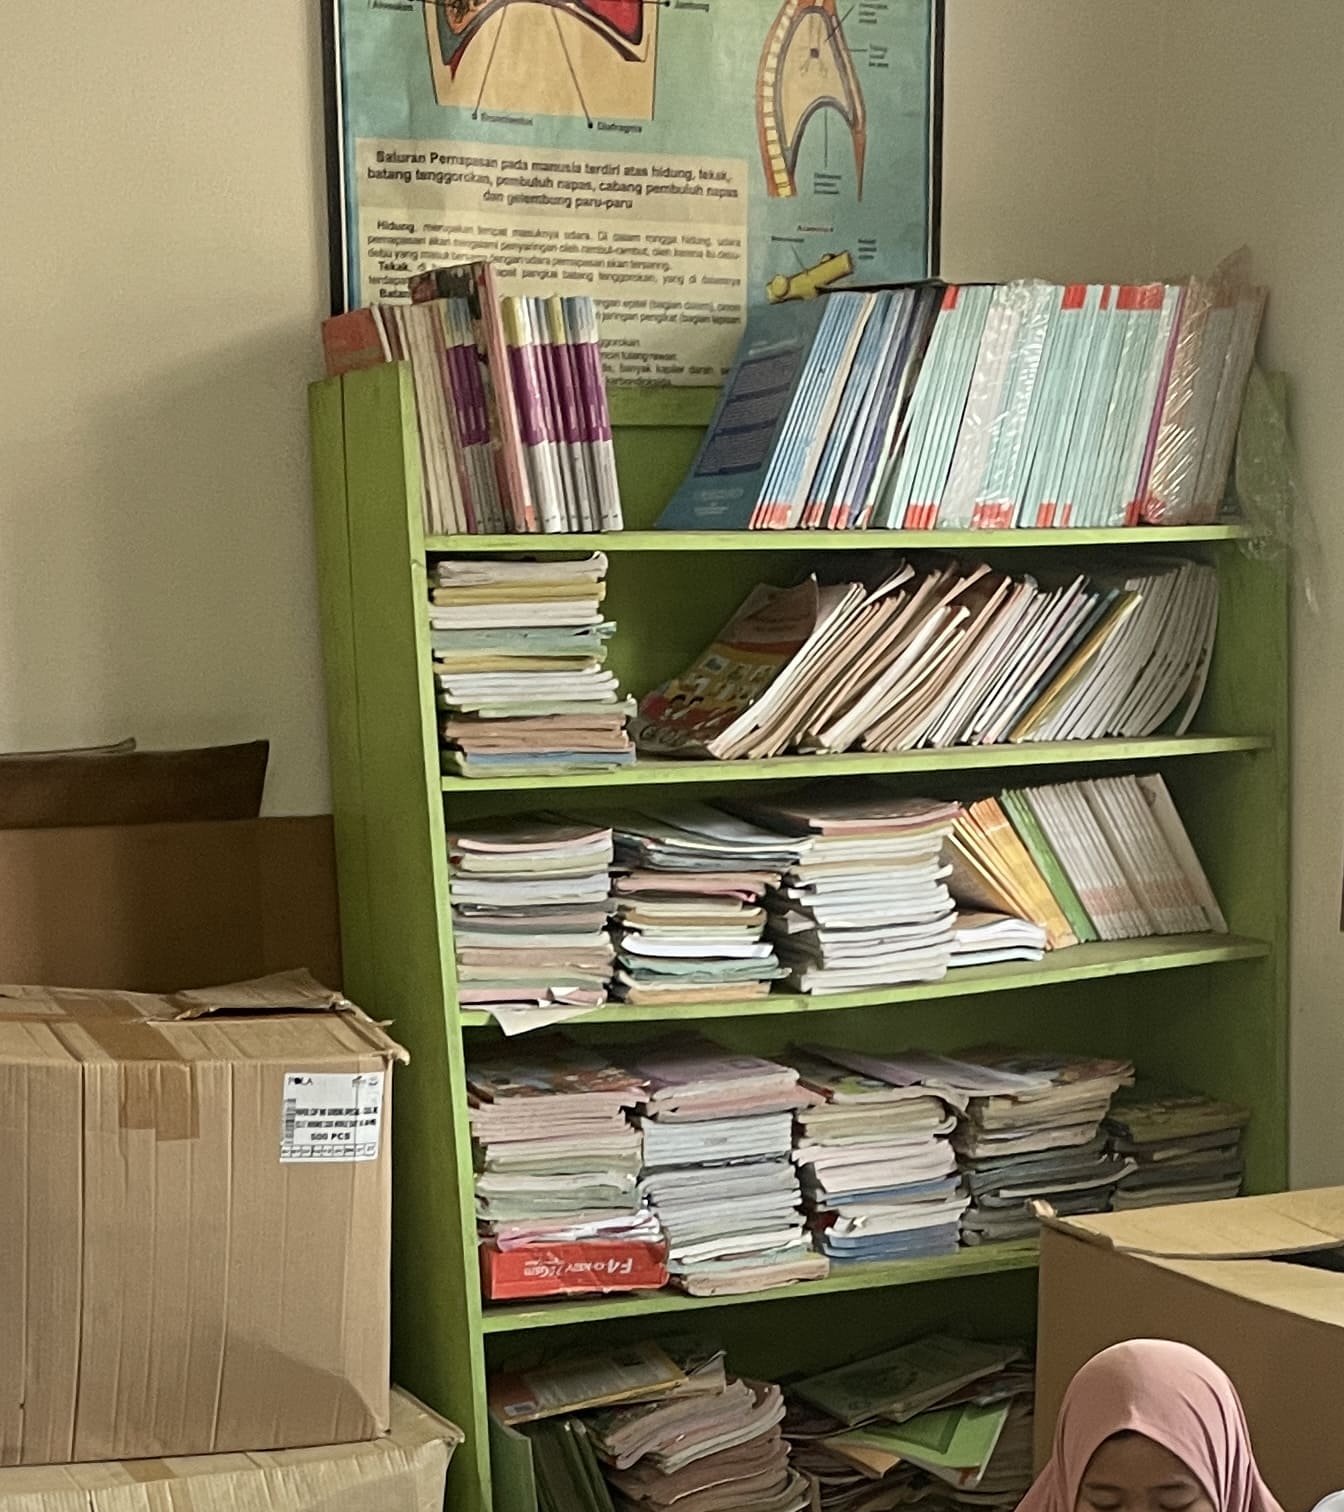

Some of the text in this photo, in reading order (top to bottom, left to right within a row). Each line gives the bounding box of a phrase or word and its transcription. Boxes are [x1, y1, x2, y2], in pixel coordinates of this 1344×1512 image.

[376, 151, 425, 163] Saluran
[501, 159, 528, 171] pada
[532, 161, 581, 173] manusia
[585, 163, 620, 176] terdiri
[623, 165, 648, 176] atas
[652, 166, 695, 182] hidung,
[367, 168, 738, 199] batang tenggorokan, pembuluh napas, cabang pembuluh napas
[483, 190, 633, 210] dan gelembung paru-paru
